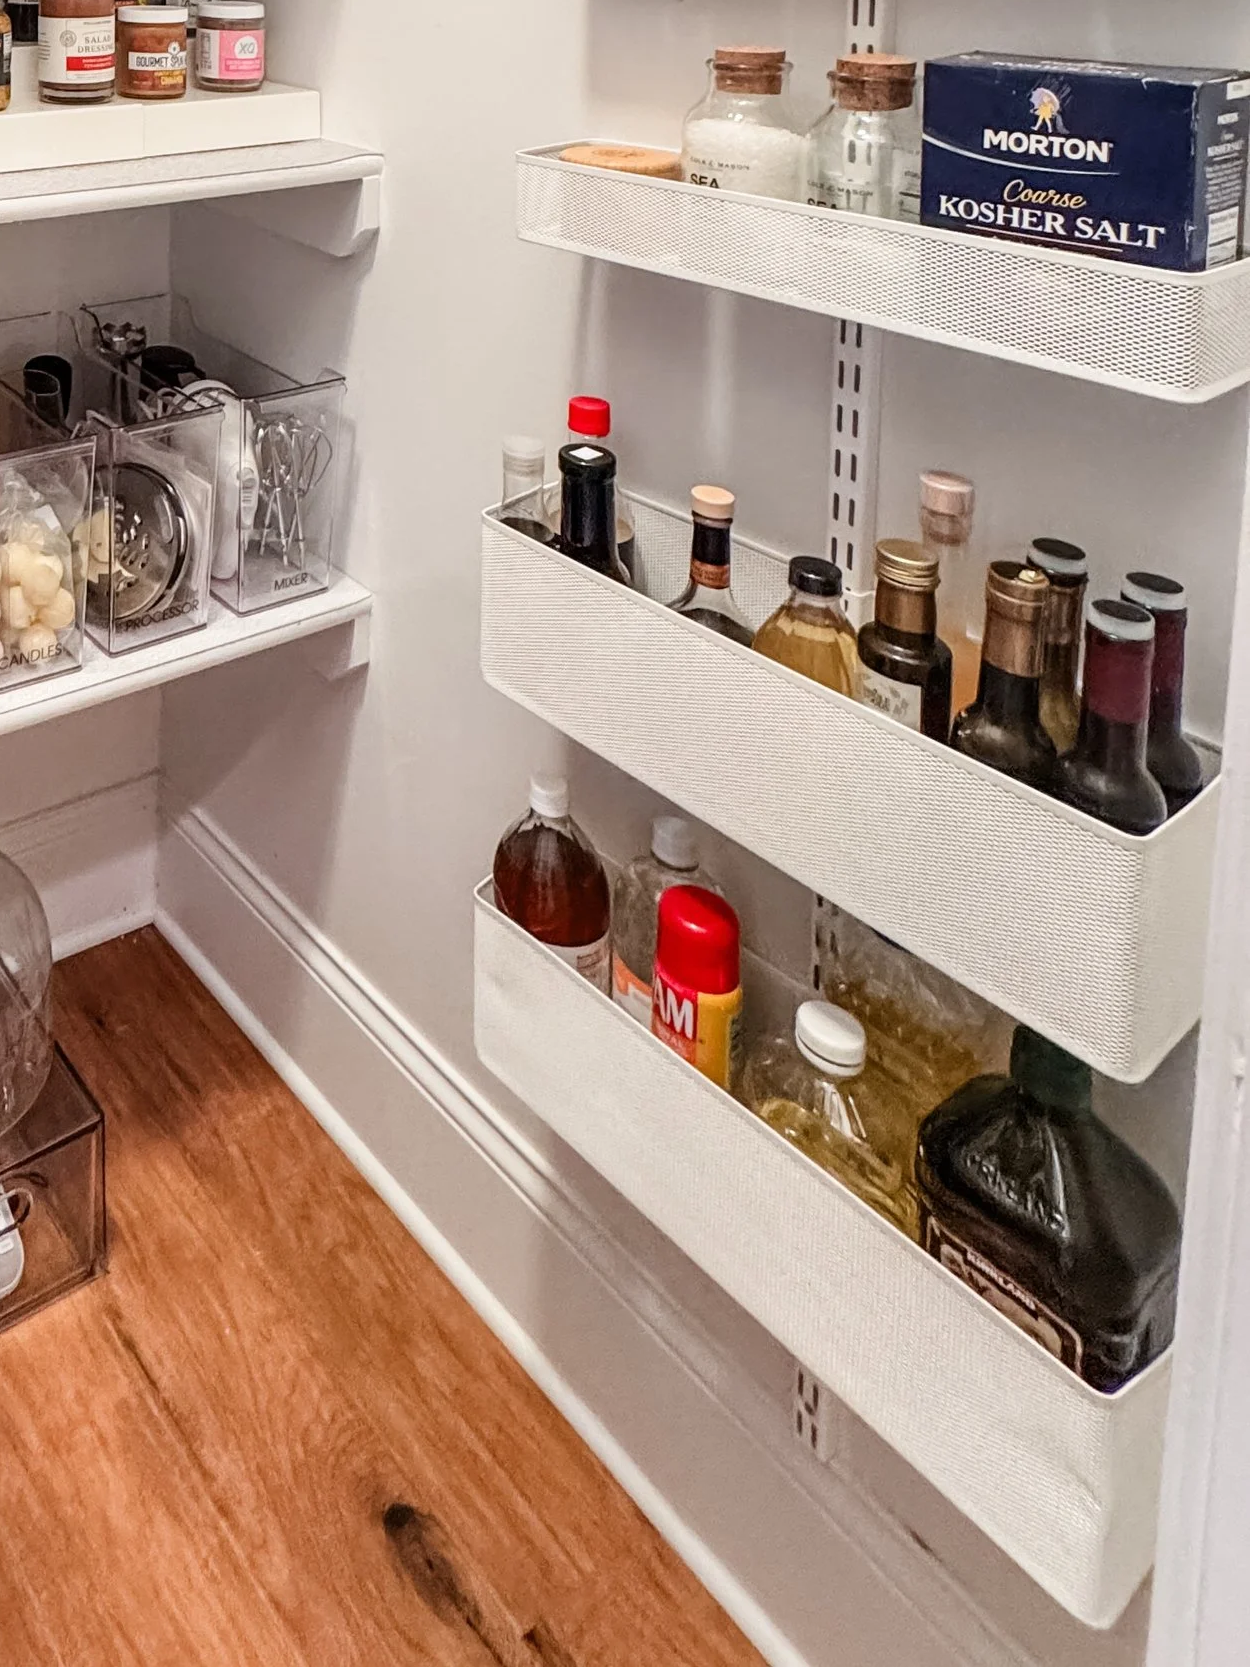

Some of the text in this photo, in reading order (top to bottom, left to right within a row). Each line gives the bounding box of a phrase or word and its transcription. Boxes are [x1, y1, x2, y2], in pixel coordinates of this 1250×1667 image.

[84, 35, 112, 45] SALAD
[135, 56, 169, 67] GOURMET
[983, 128, 1110, 163] MORTON
[716, 160, 750, 171] MASON
[690, 173, 720, 189] SEA
[837, 186, 873, 197] MASON
[1003, 178, 1087, 210] Coarse
[938, 194, 1166, 250] KOSHER SALT
[273, 571, 308, 592] MIXER
[124, 598, 200, 631] PROCESSOR
[653, 973, 695, 1041] AM
